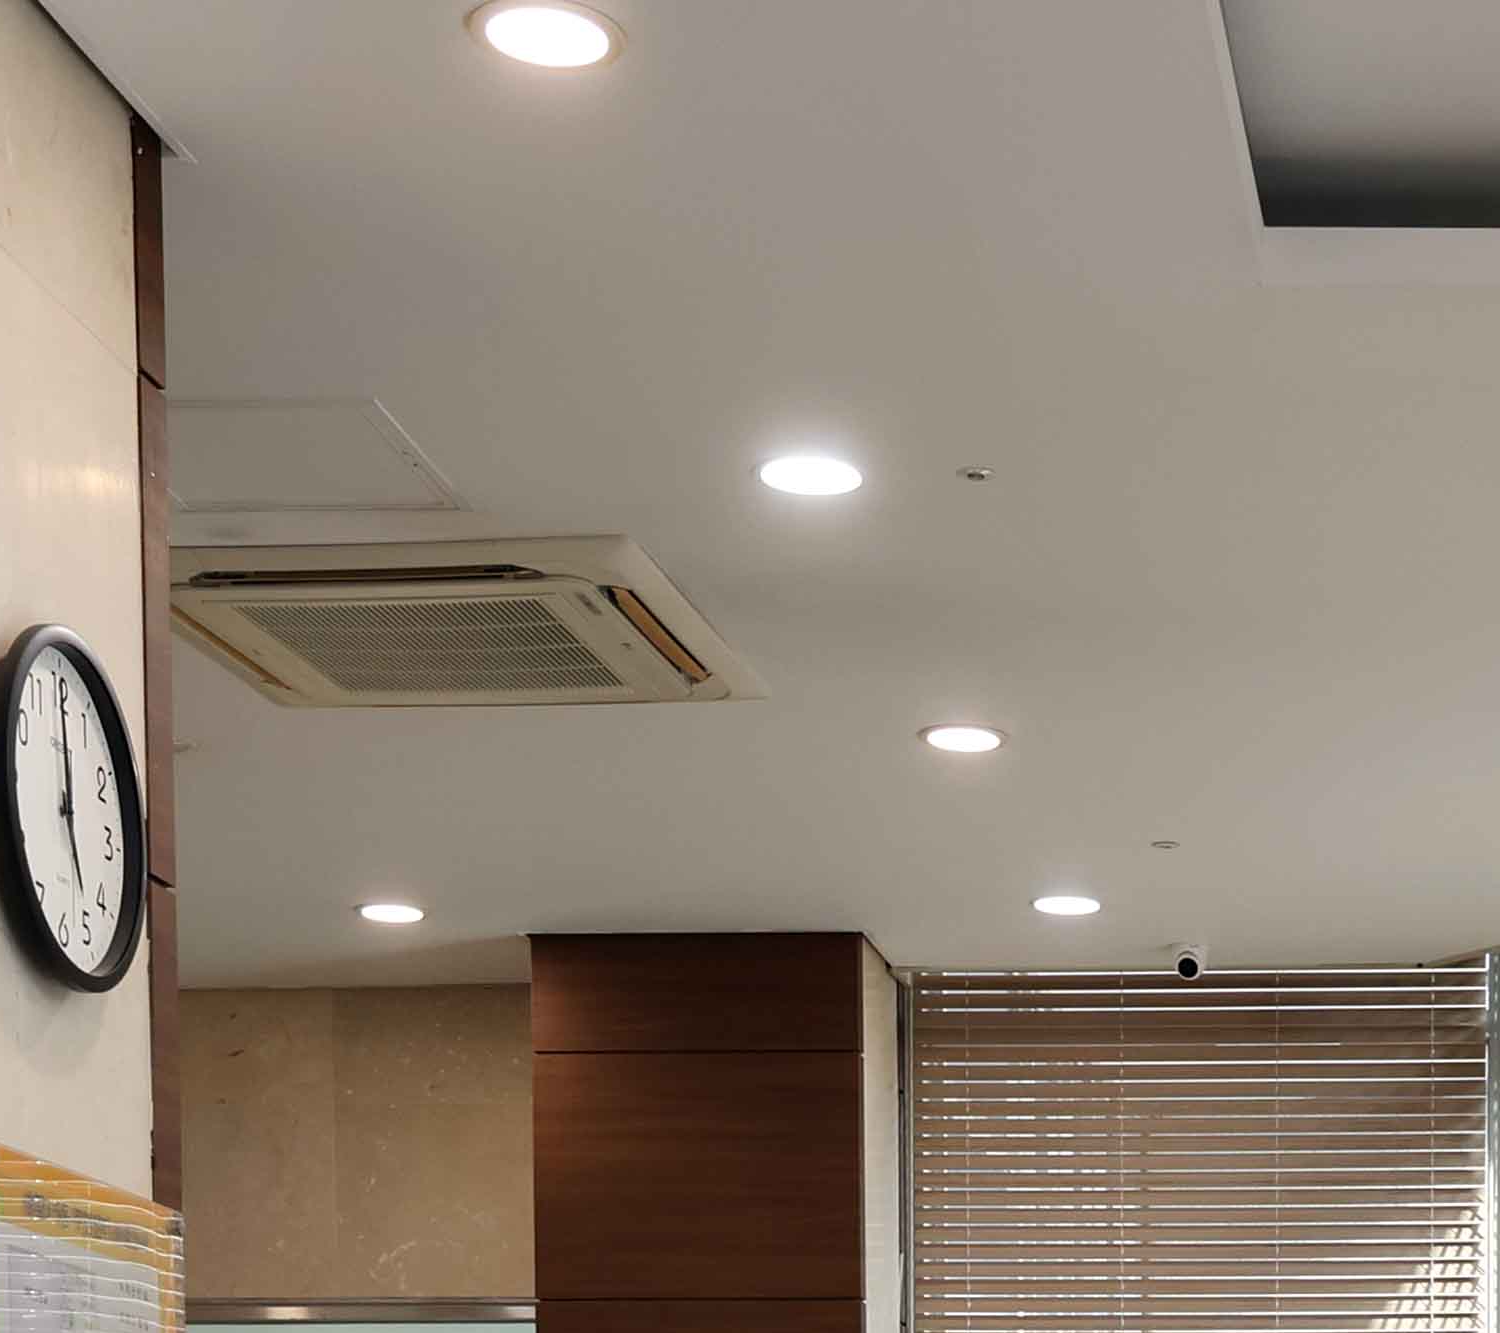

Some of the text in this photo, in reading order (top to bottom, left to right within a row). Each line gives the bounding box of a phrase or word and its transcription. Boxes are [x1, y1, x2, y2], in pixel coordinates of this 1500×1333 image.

[18, 708, 29, 746] 0
[96, 766, 107, 804] 2
[103, 826, 113, 861] 3
[96, 882, 106, 916] 4
[59, 912, 69, 947] 6
[82, 910, 92, 946] 5
